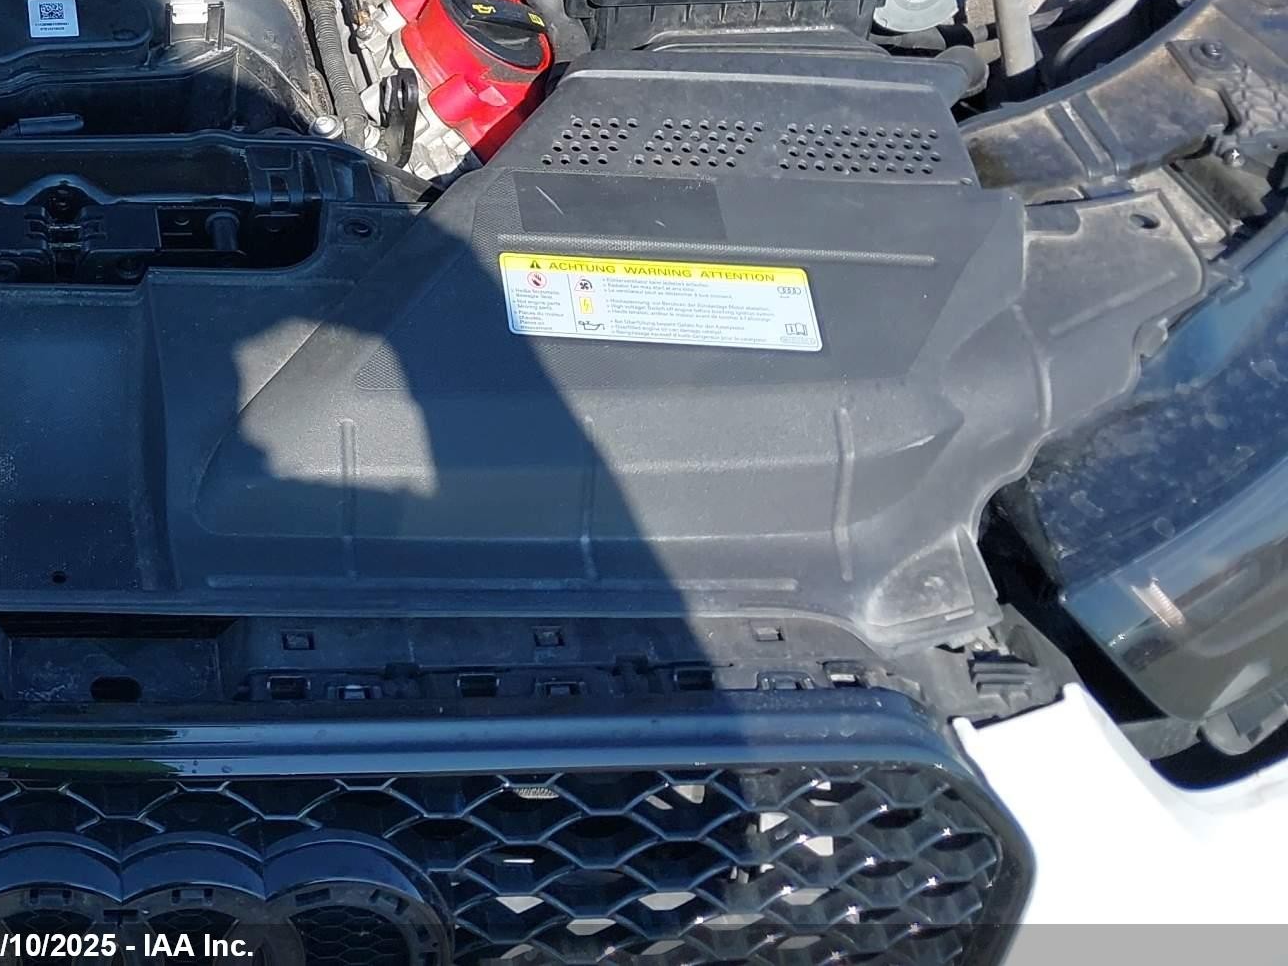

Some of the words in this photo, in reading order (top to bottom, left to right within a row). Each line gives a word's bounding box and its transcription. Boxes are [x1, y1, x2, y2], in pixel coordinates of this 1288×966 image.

[549, 261, 616, 274] ACHTUNG
[623, 266, 692, 278] WARNING
[700, 270, 776, 282] ATTENTION
